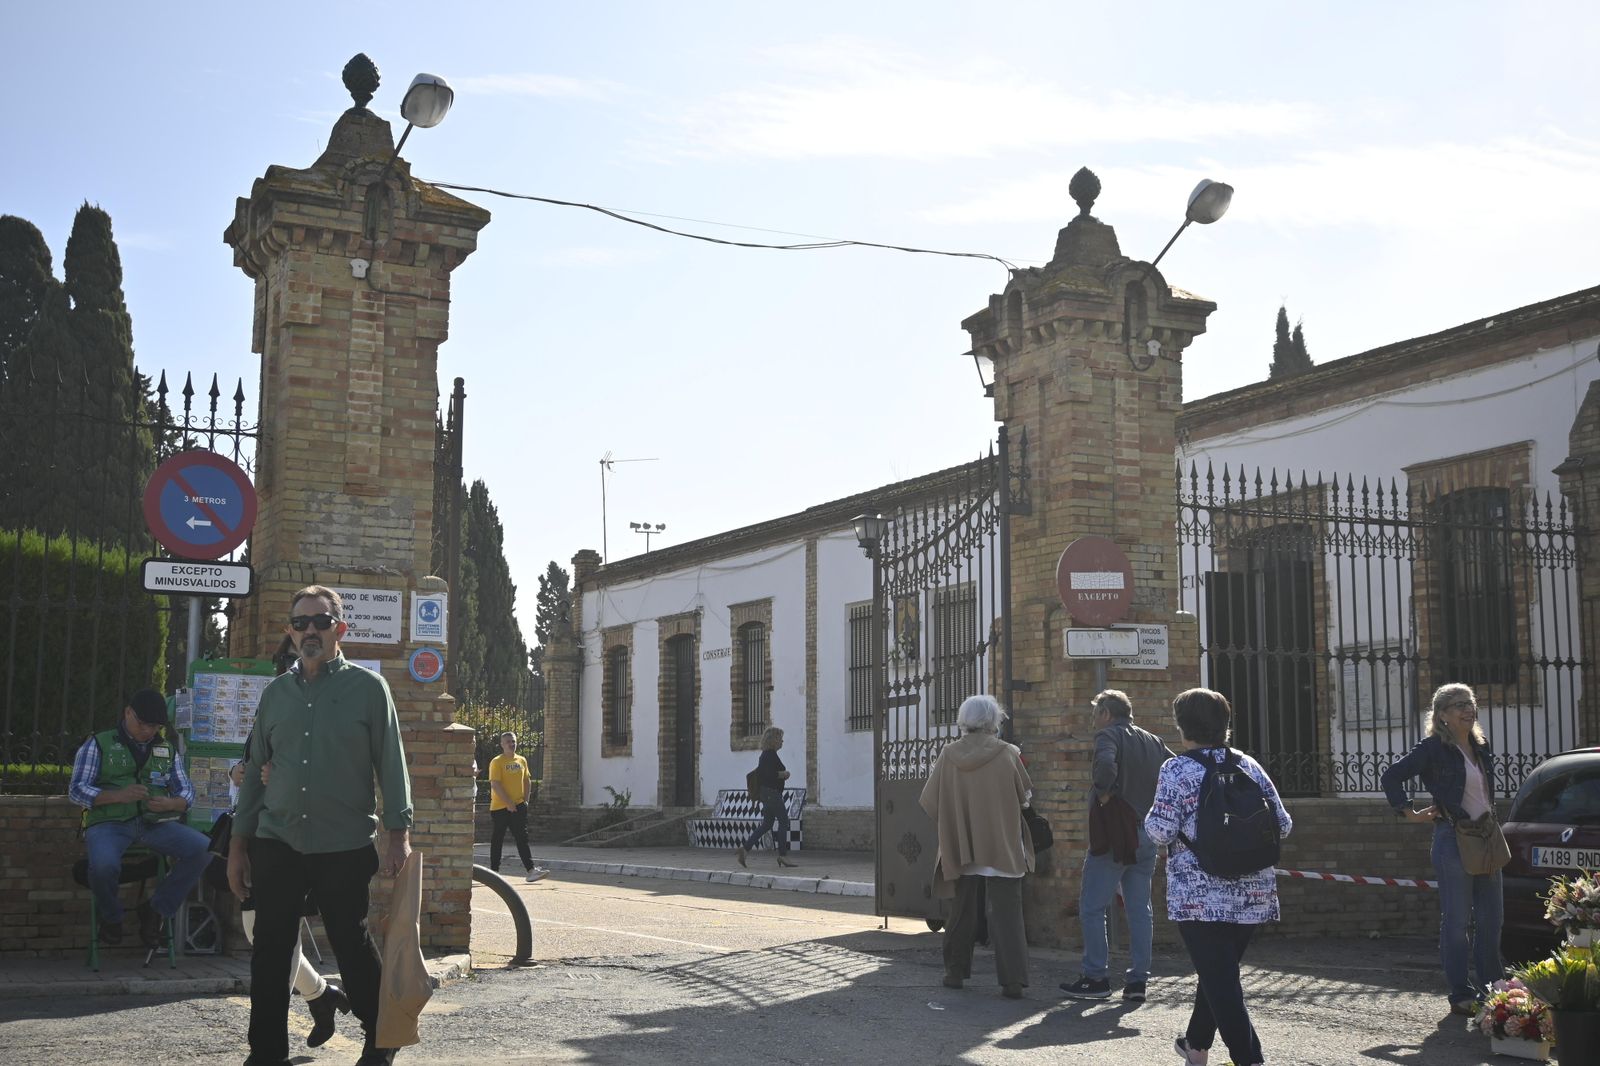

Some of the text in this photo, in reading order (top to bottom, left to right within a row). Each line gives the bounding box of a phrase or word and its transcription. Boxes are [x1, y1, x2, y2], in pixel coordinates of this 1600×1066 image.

[192, 496, 226, 505] METROS
[171, 565, 222, 576] EXCEPTO
[155, 577, 236, 589] MINUSVALIDOS
[359, 593, 369, 601] DE
[372, 594, 398, 603] VISITAS
[1078, 592, 1119, 601] EXCEPTO
[1541, 849, 1571, 866] 4189
